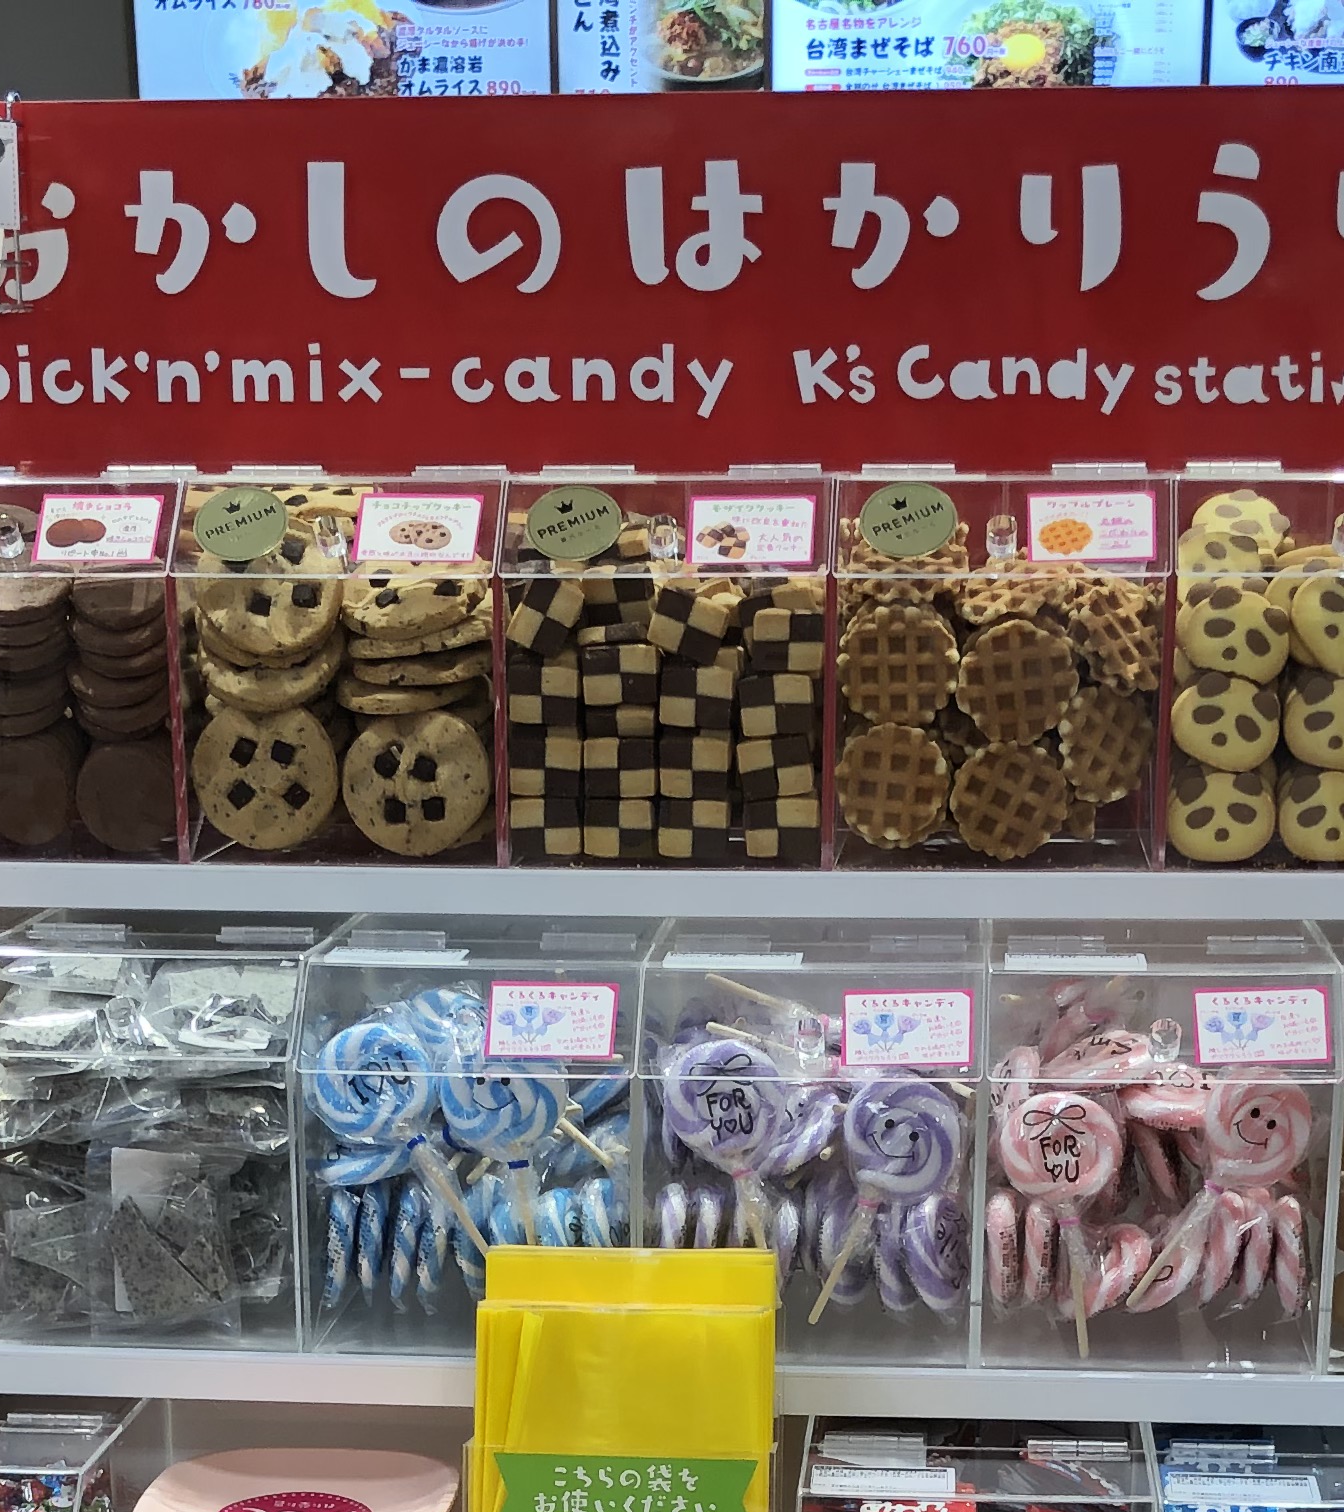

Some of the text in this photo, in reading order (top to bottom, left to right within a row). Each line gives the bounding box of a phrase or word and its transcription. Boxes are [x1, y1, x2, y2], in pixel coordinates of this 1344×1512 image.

[805, 17, 922, 30] 名古屋名物をアレンジ
[806, 35, 987, 60] 台湾まぜそば 760
[400, 79, 522, 96] オムライス 890
[896, 345, 1134, 416] Candy
[372, 501, 472, 512] チョコチップクッキー
[712, 503, 796, 513] モザイククッキー
[871, 501, 946, 538] PREMIUM
[204, 504, 279, 541] PREMIUM
[536, 504, 613, 541] PREMIUM
[706, 1087, 752, 1118] FOR
[1039, 1133, 1081, 1161] FOR
[553, 1463, 700, 1493] こちらの袋を
